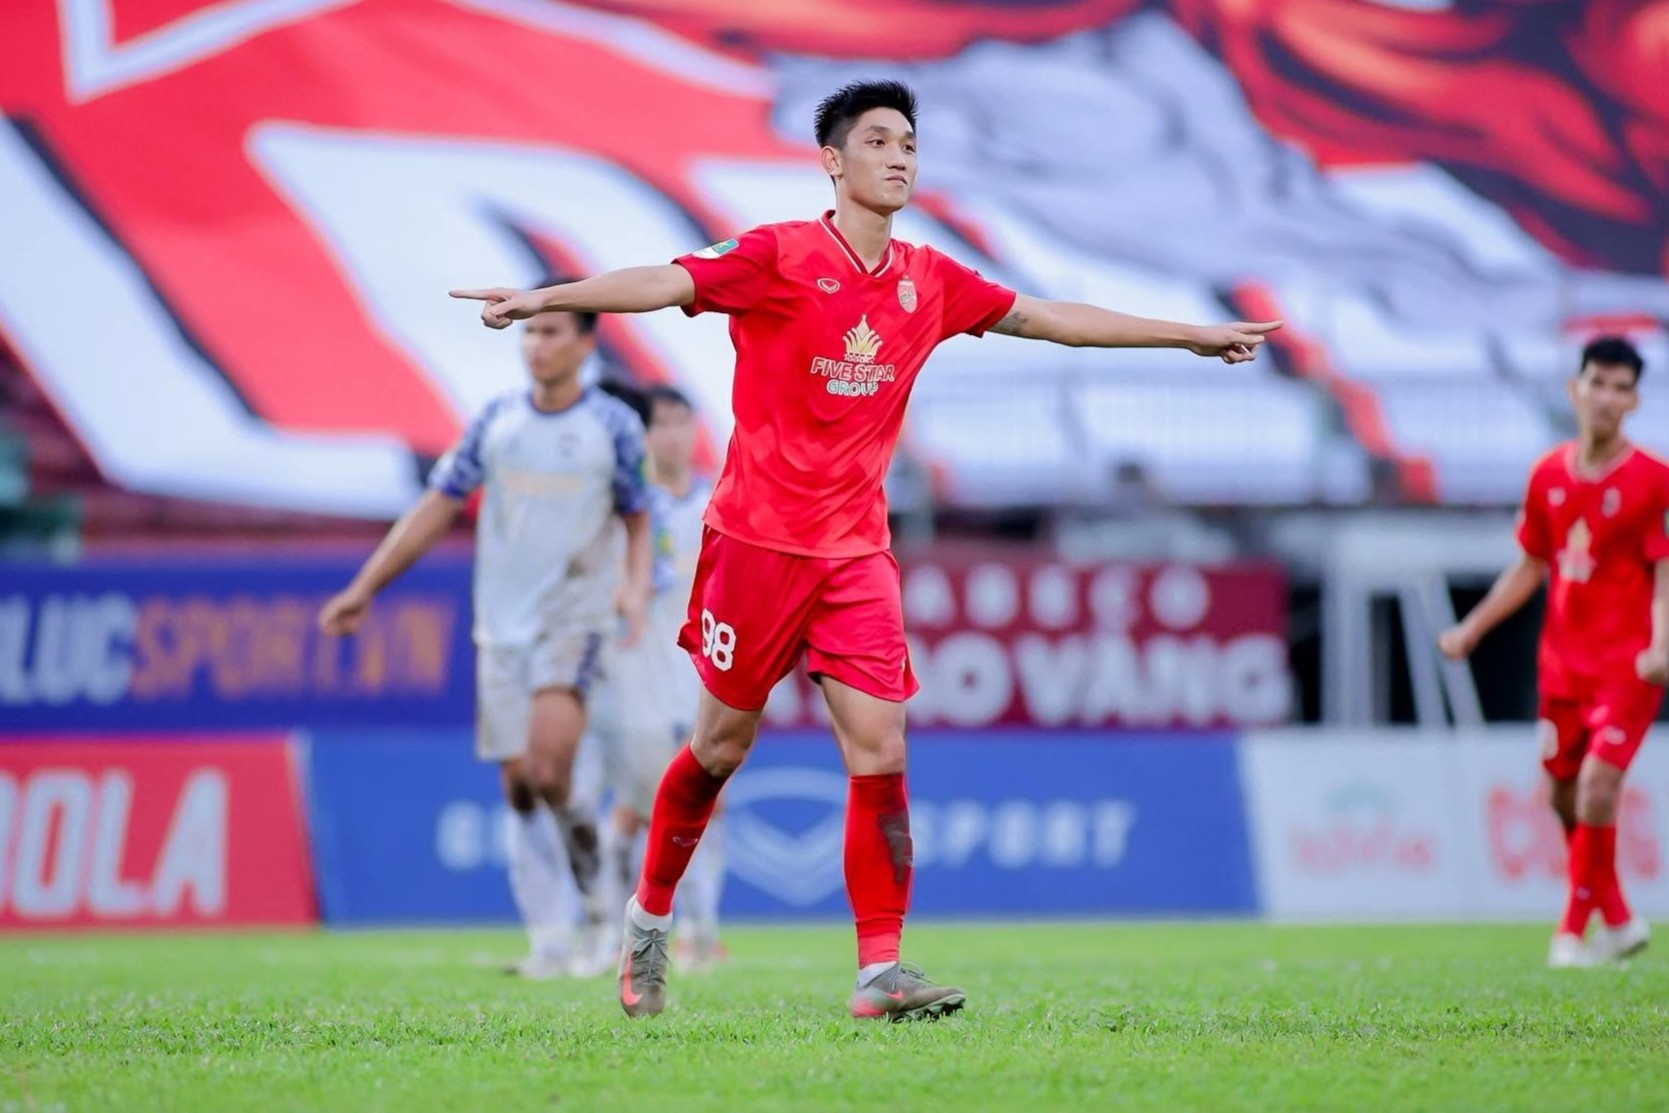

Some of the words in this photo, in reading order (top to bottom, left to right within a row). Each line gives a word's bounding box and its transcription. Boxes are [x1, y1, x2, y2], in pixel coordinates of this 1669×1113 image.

[810, 356, 853, 381] FIVE
[854, 364, 895, 382] STAR
[826, 379, 879, 397] GROUP
[702, 608, 737, 672] 98
